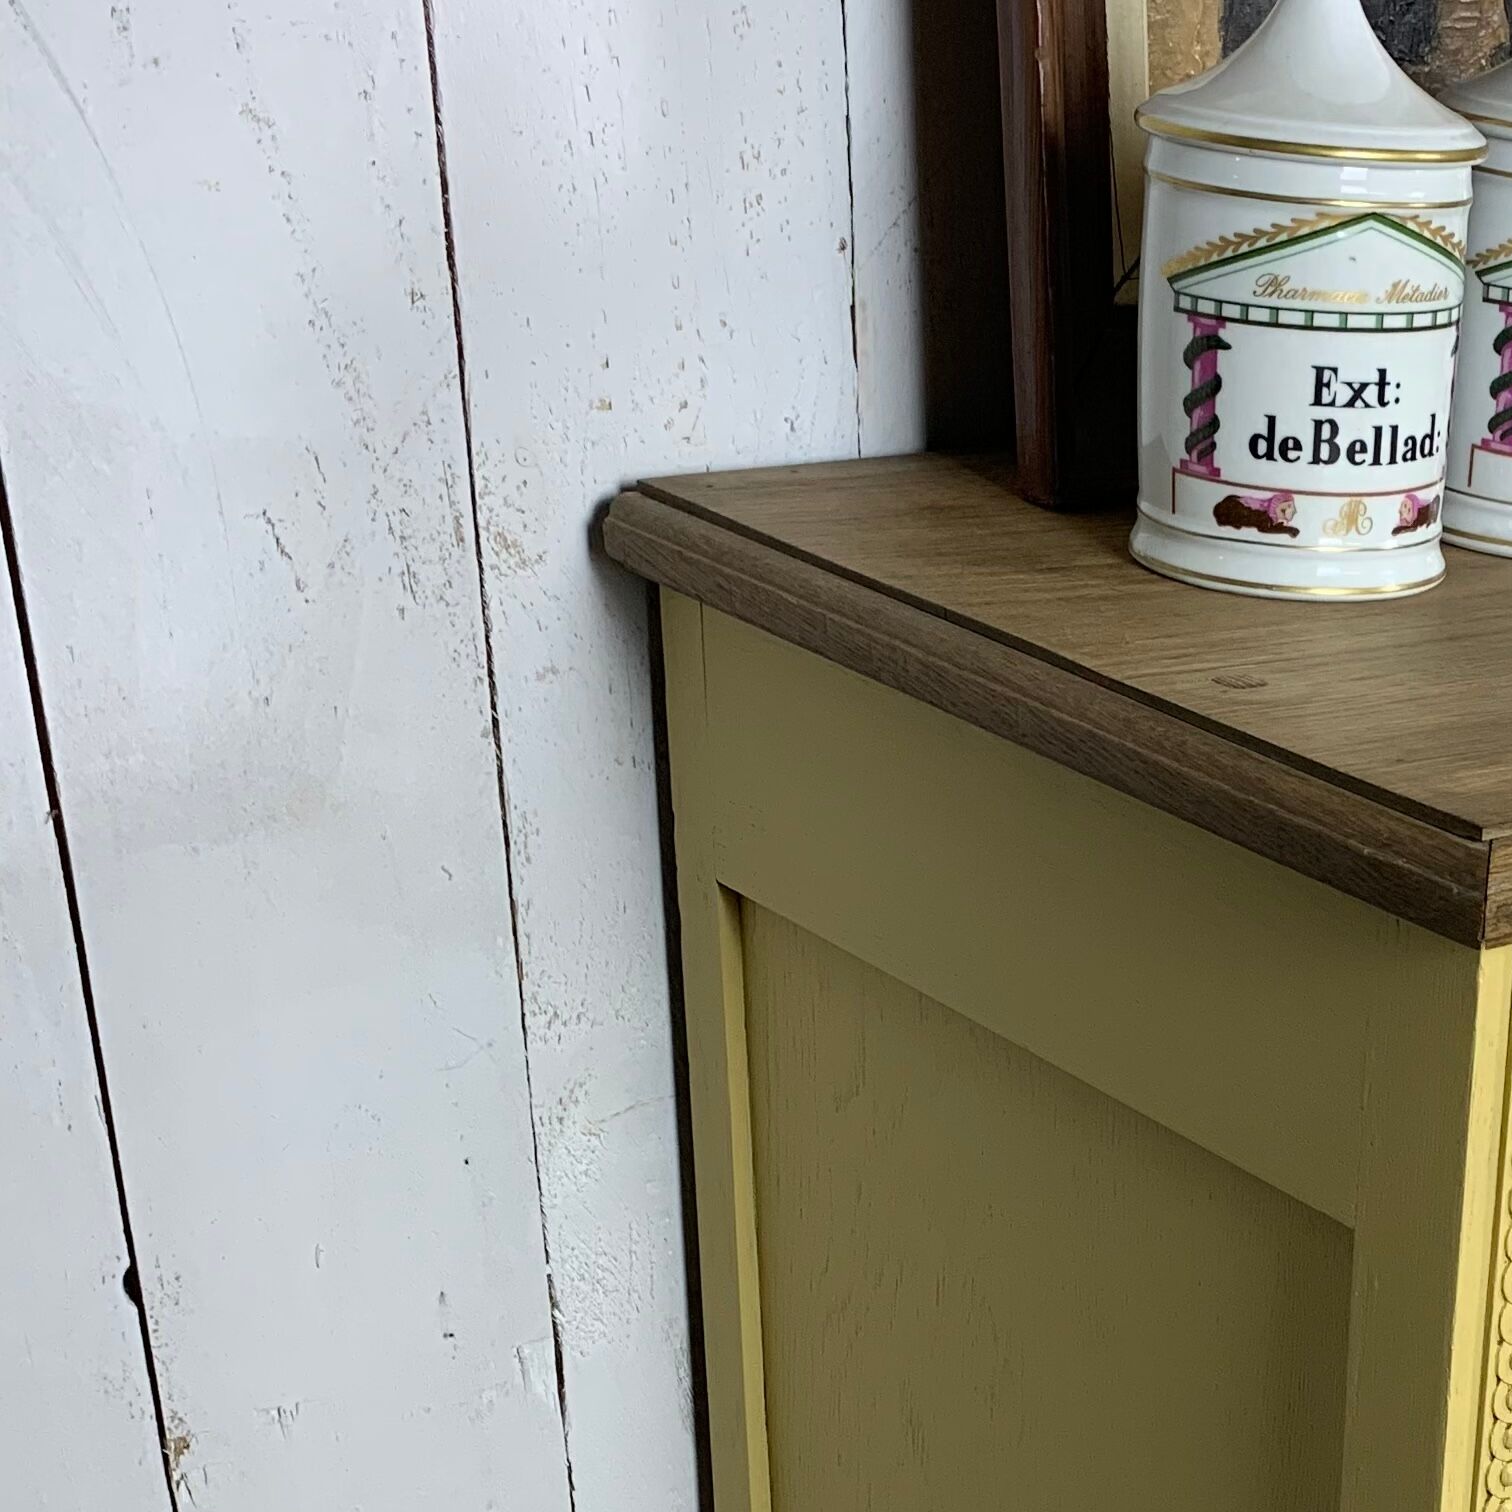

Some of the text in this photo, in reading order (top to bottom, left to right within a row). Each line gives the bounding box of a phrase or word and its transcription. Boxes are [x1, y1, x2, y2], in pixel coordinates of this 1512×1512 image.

[1309, 364, 1402, 409] Ext:
[1247, 413, 1441, 467] de Bellad:
